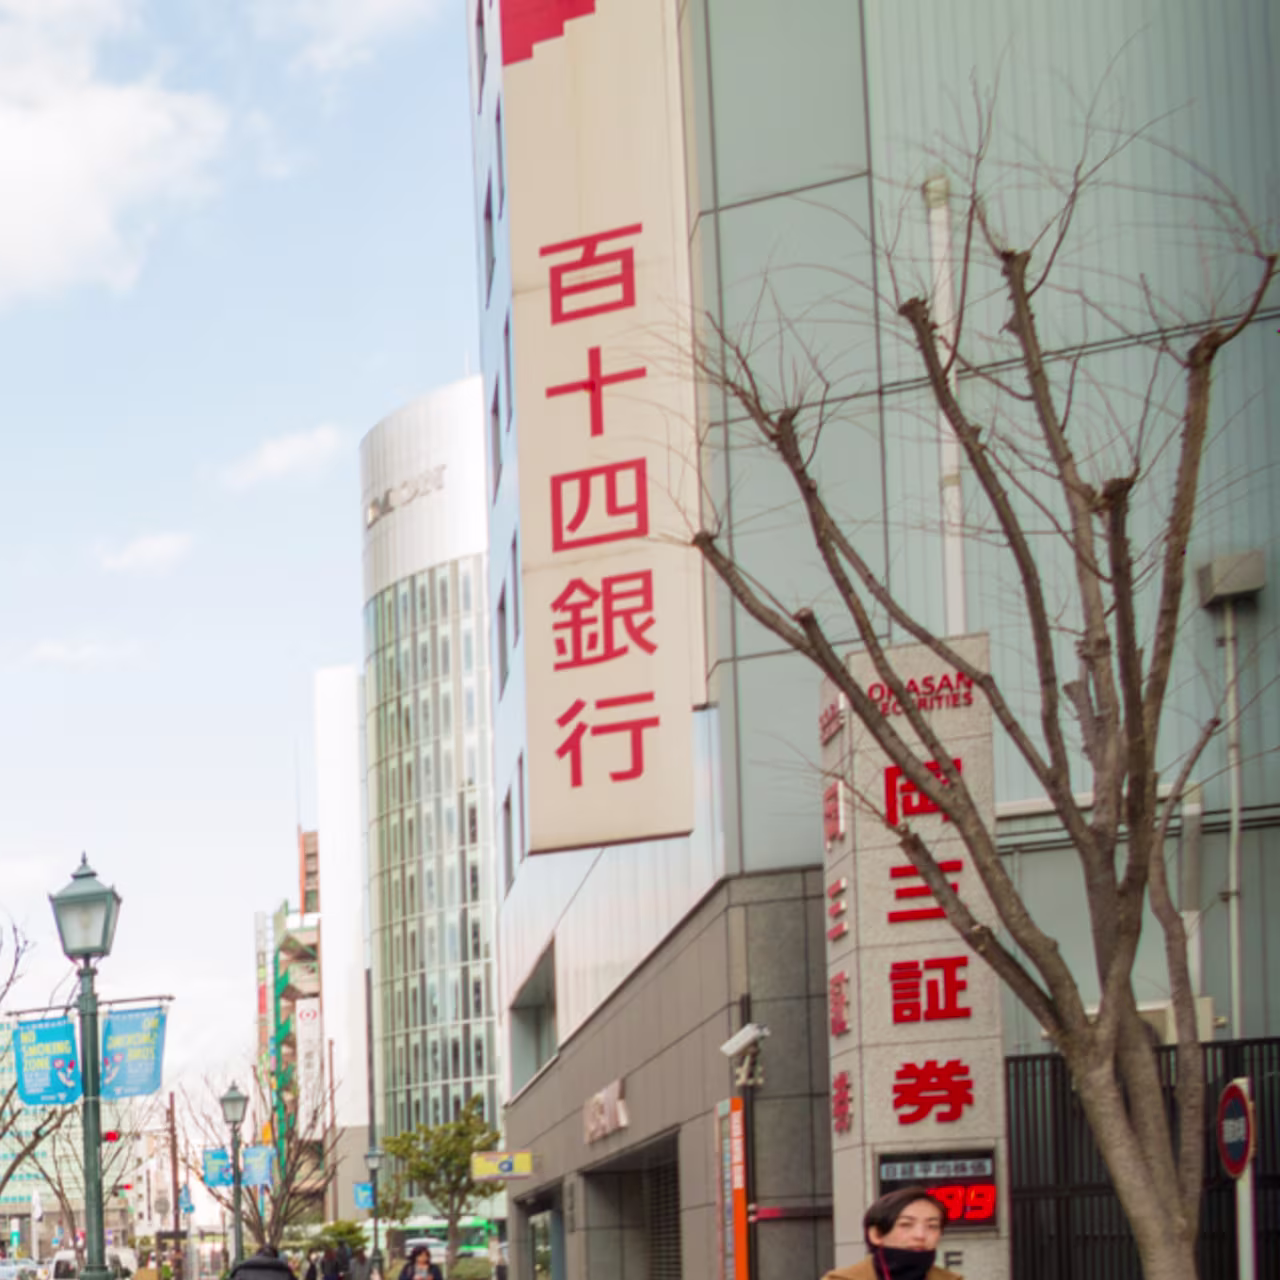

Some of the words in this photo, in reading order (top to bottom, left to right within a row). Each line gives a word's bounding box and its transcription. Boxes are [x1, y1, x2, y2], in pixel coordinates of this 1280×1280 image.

[539, 223, 661, 788] 百十四銀行
[867, 671, 975, 703] OASAN
[878, 691, 975, 717] ECRITIES
